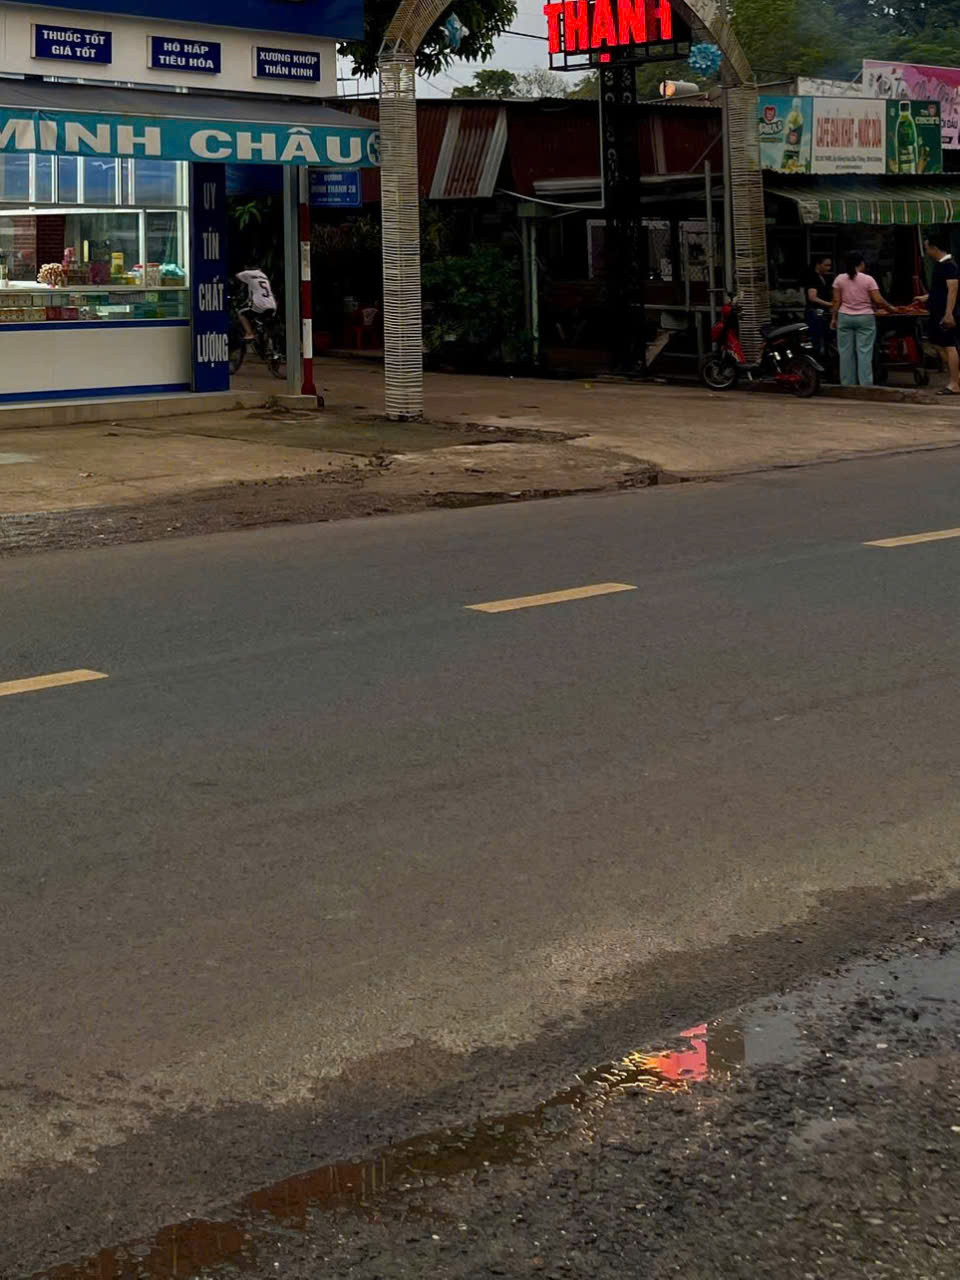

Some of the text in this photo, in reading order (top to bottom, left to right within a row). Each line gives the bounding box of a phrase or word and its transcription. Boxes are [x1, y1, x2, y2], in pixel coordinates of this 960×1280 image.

[290, 66, 314, 78] KINH
[189, 126, 363, 165] CHÂU
[203, 182, 217, 210] UY
[202, 226, 220, 261] TÍN
[198, 275, 225, 312] CHẤT
